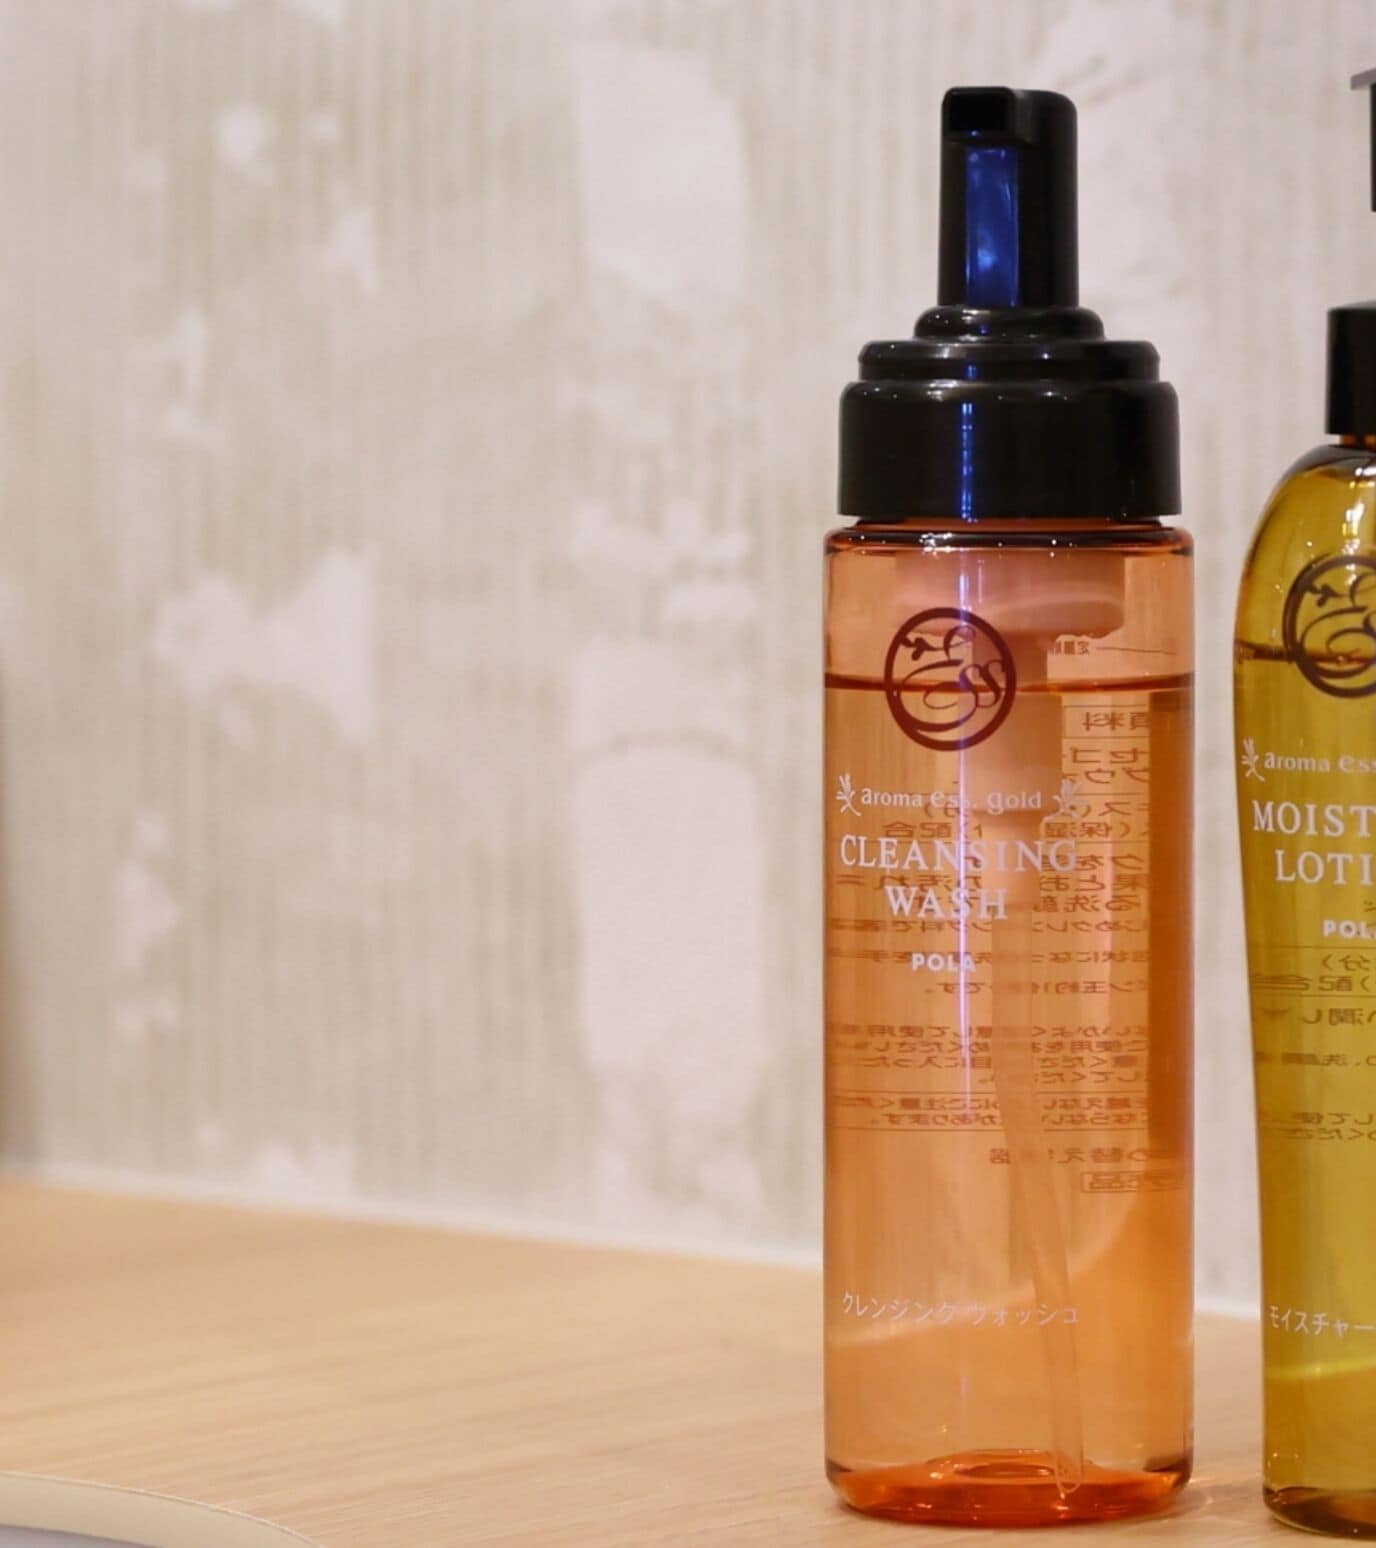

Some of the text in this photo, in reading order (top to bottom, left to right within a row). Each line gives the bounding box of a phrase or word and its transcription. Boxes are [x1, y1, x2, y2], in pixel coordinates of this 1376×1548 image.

[1264, 752, 1331, 772] aroma
[861, 787, 923, 807] aroma
[986, 791, 1042, 814] gold
[840, 834, 1077, 873] CLEANSING
[884, 885, 1009, 921] WASH
[911, 953, 977, 972] POLA
